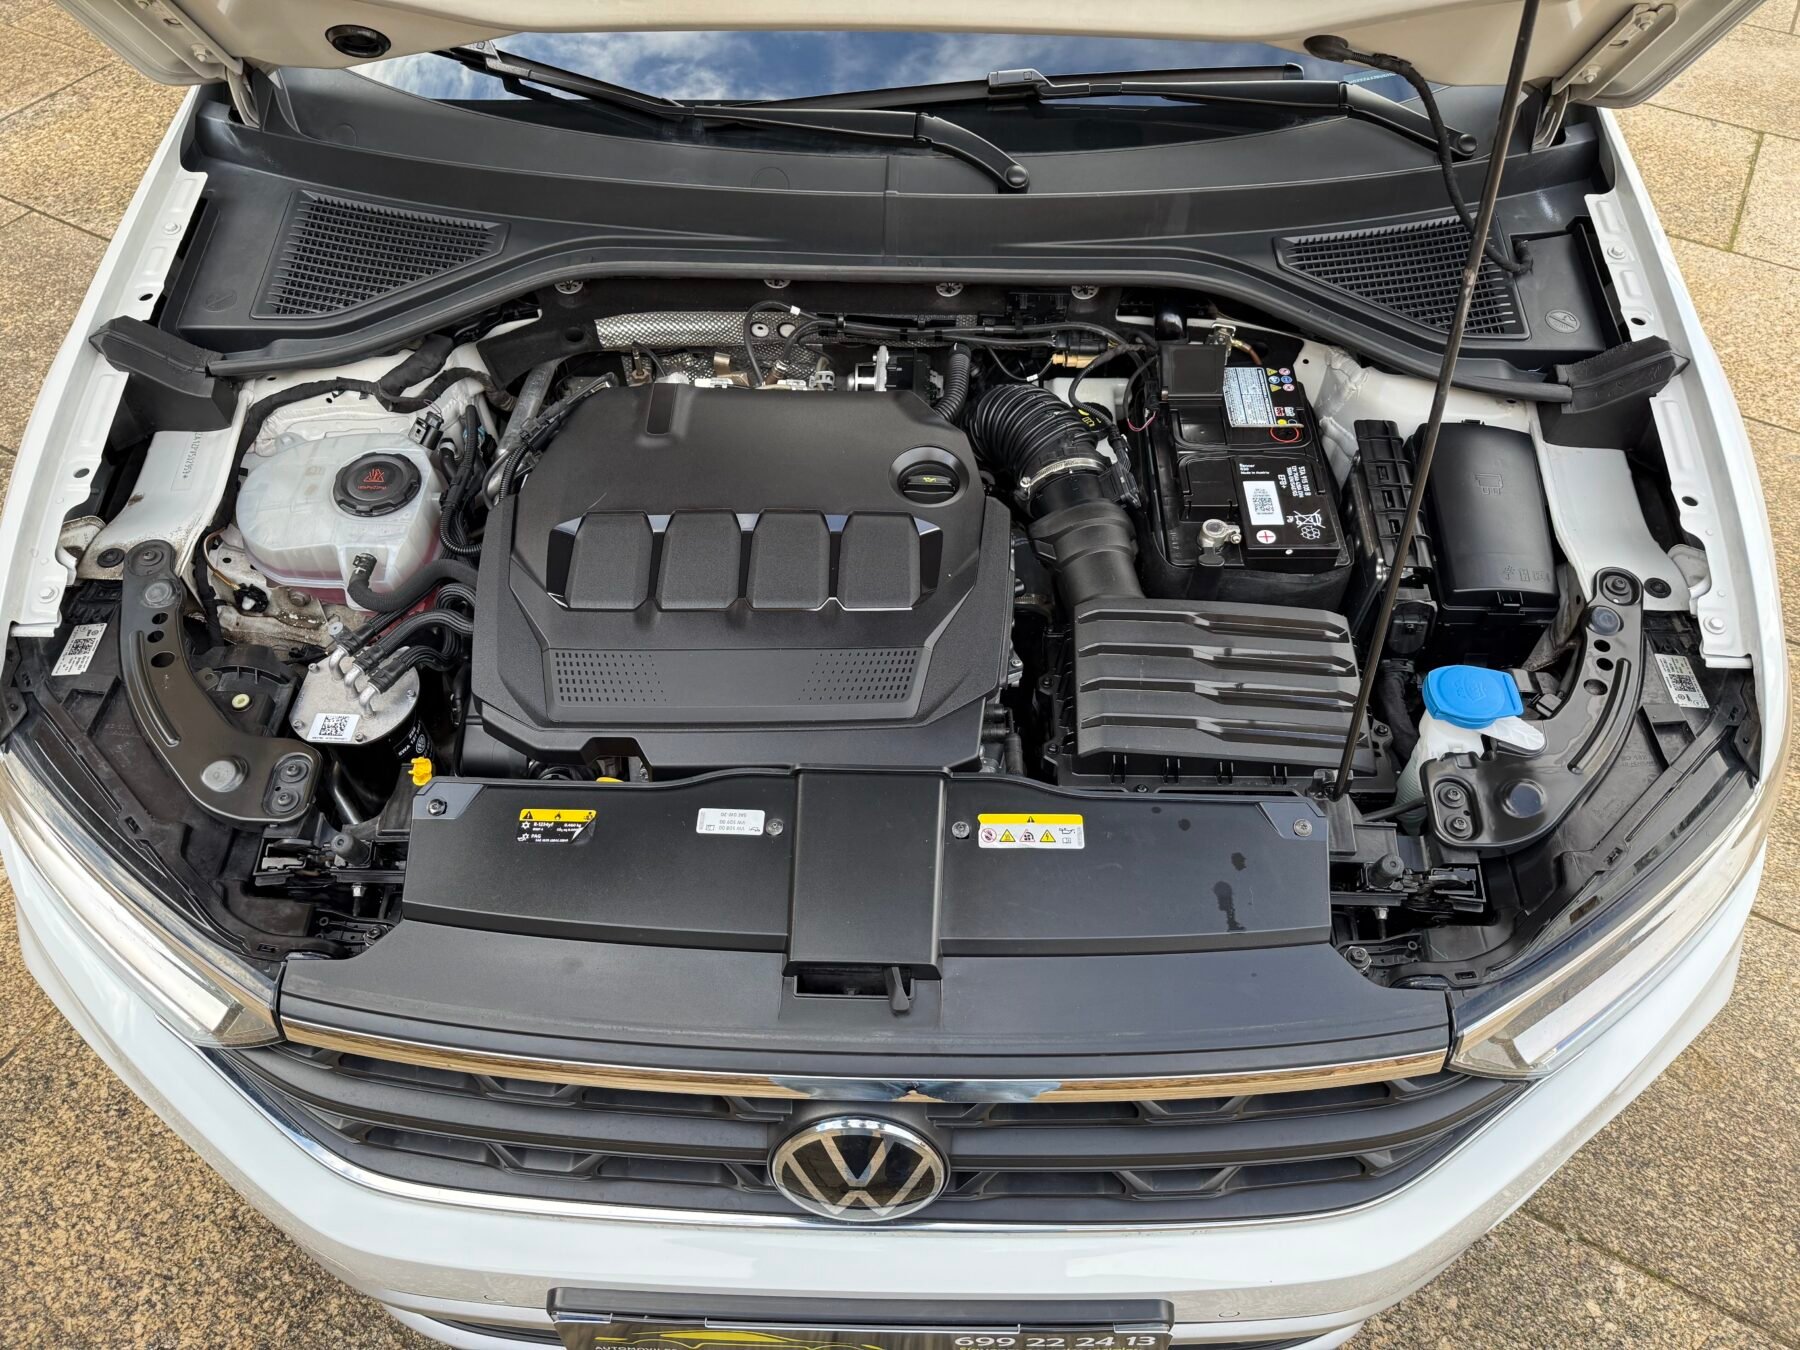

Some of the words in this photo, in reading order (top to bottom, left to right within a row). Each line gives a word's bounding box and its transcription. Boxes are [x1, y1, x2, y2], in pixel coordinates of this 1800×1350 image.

[954, 1336, 1016, 1347] 699
[1026, 1337, 1065, 1347] 22
[1075, 1336, 1115, 1347] 24
[1126, 1336, 1157, 1346] 13
